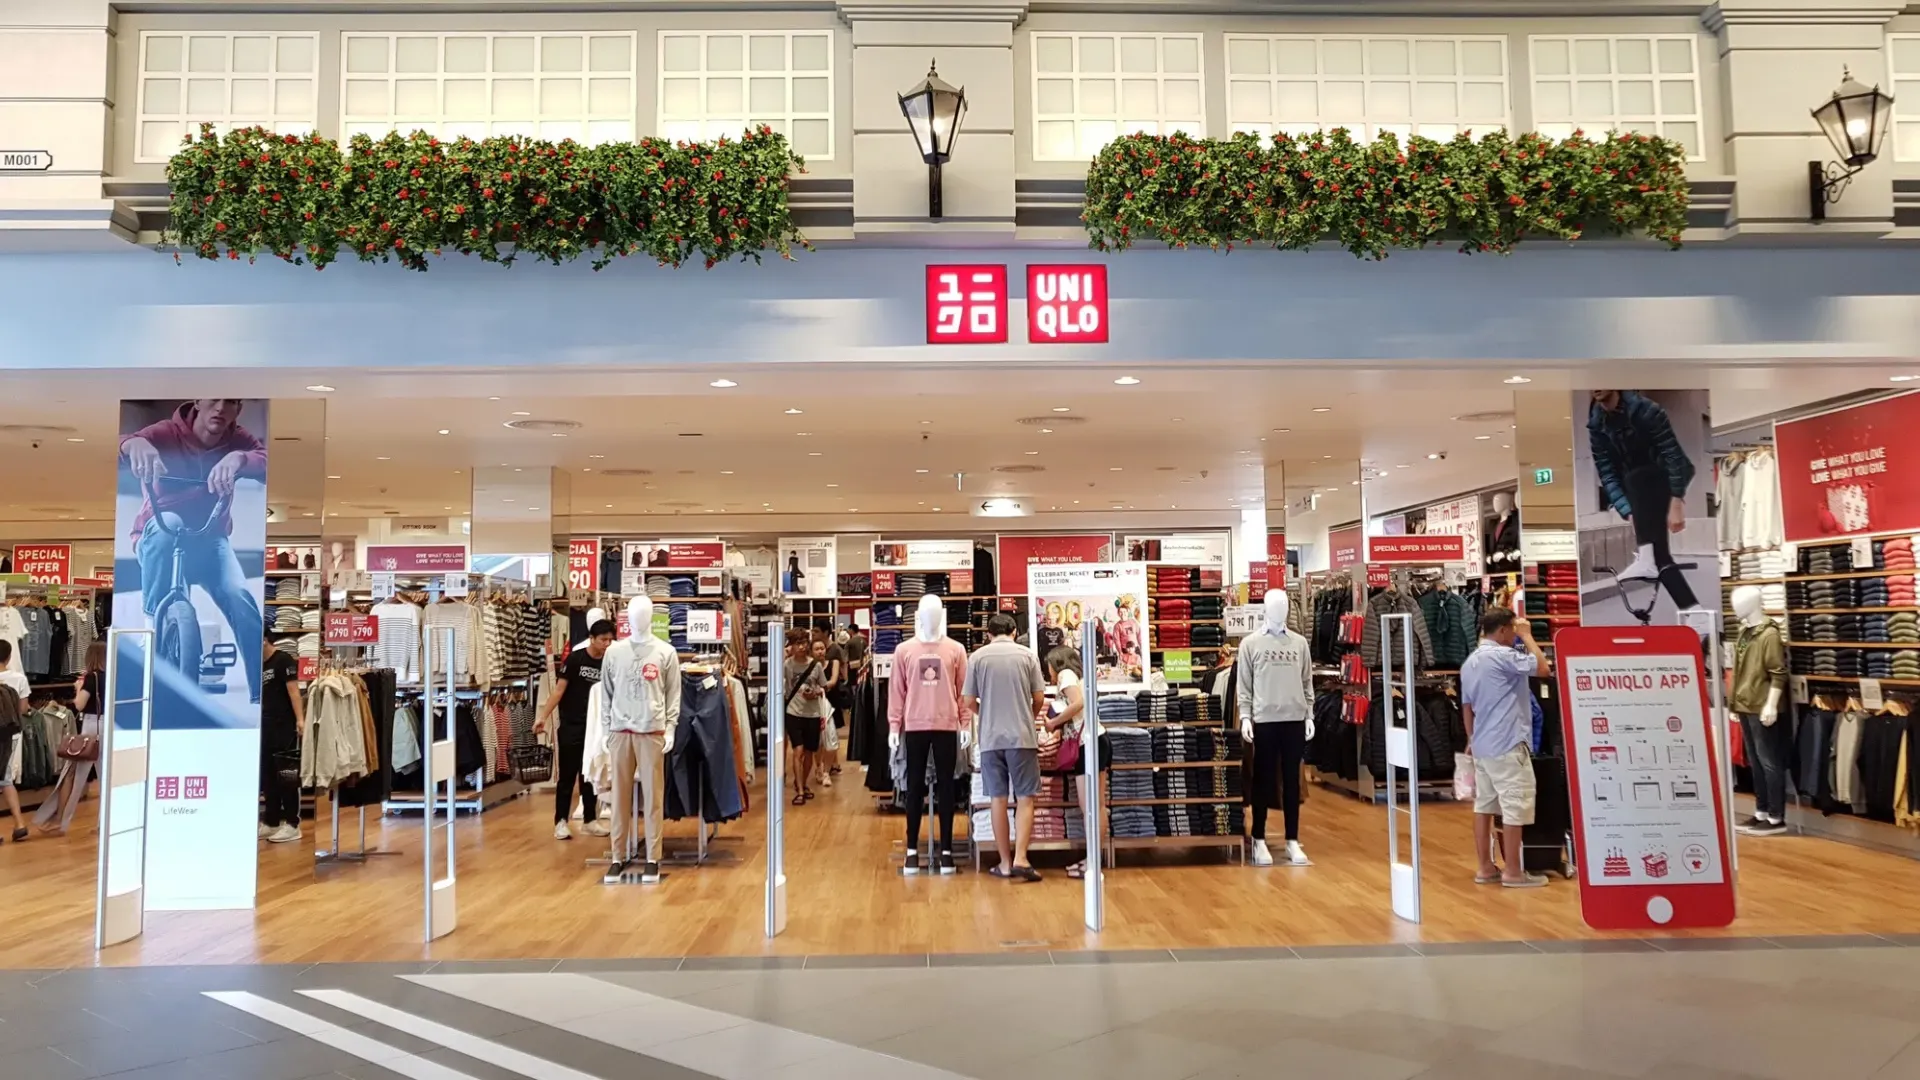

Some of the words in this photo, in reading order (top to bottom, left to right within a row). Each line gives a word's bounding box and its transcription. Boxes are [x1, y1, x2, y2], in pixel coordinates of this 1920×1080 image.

[4, 154, 38, 166] M001
[937, 272, 996, 302] ユニ
[1036, 273, 1093, 302] UNI
[936, 305, 996, 334] クロ
[1036, 304, 1099, 338] QLO
[1810, 458, 1827, 471] GIVE
[1827, 454, 1849, 468] WHAT
[1849, 451, 1865, 464] YOU
[1865, 446, 1886, 461] LOVE
[1811, 471, 1831, 484] LOVE
[1831, 466, 1853, 481] WHAT
[1853, 464, 1869, 476] YOU
[1869, 461, 1888, 474] GIVE
[18, 549, 66, 560] SPECIAL
[1400, 544, 1420, 552] OFFER
[23, 562, 60, 573] OFFER
[1596, 674, 1653, 692] UNIQLO
[1660, 674, 1690, 689] APP
[186, 778, 204, 787] UNI
[186, 788, 205, 798] QLO
[162, 807, 199, 815] LifeWear
